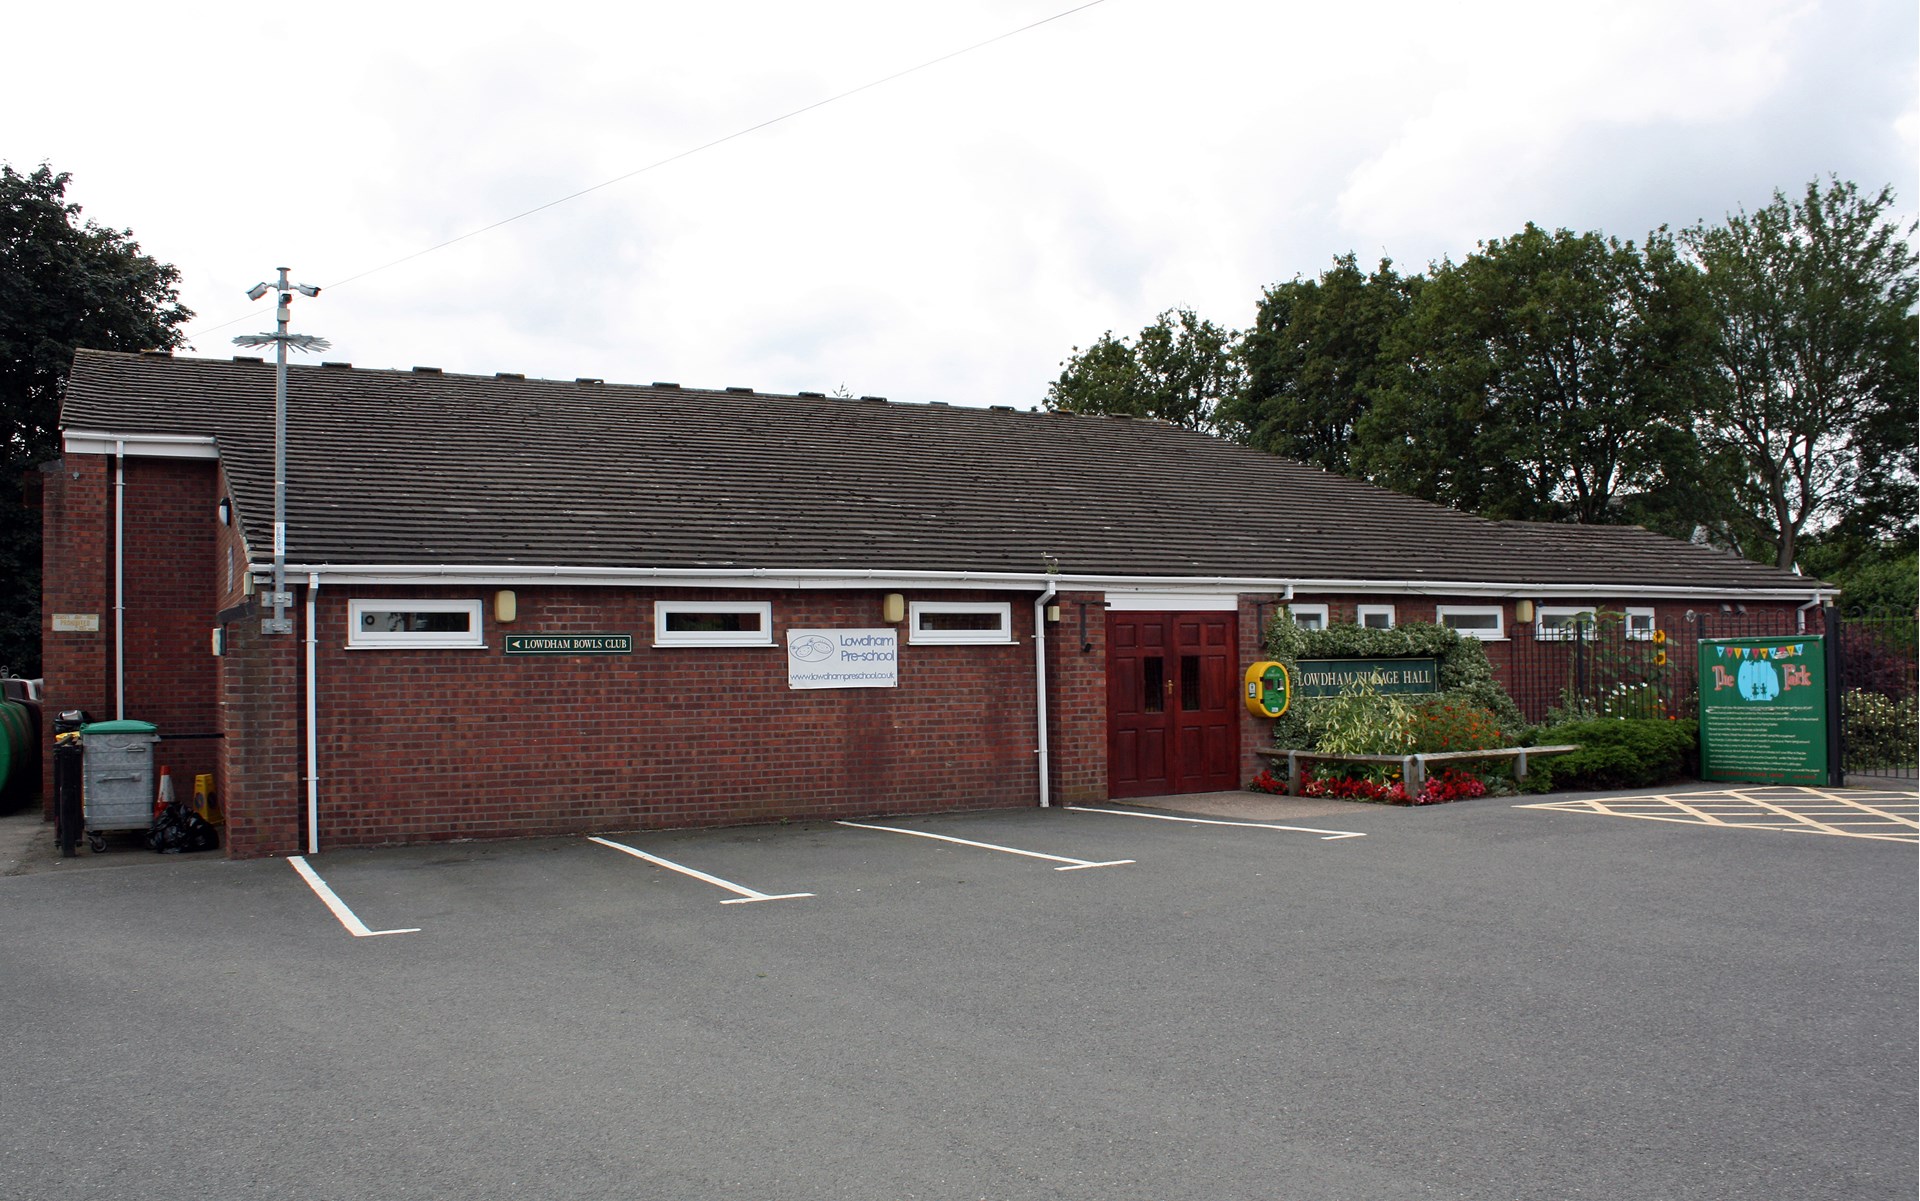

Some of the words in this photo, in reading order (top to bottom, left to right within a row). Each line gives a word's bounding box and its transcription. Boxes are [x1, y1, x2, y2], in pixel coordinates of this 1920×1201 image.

[524, 639, 571, 649] LOWDHAM
[573, 639, 602, 649] BOWLS
[605, 639, 627, 649] CLUB
[840, 634, 894, 646] Lowdham
[841, 650, 895, 661] Pre-school
[1297, 671, 1352, 686] LOWDHAM
[1356, 670, 1399, 684] VILAGE
[1403, 670, 1432, 683] HALL
[1712, 665, 1735, 691] The
[1781, 663, 1812, 691] Park
